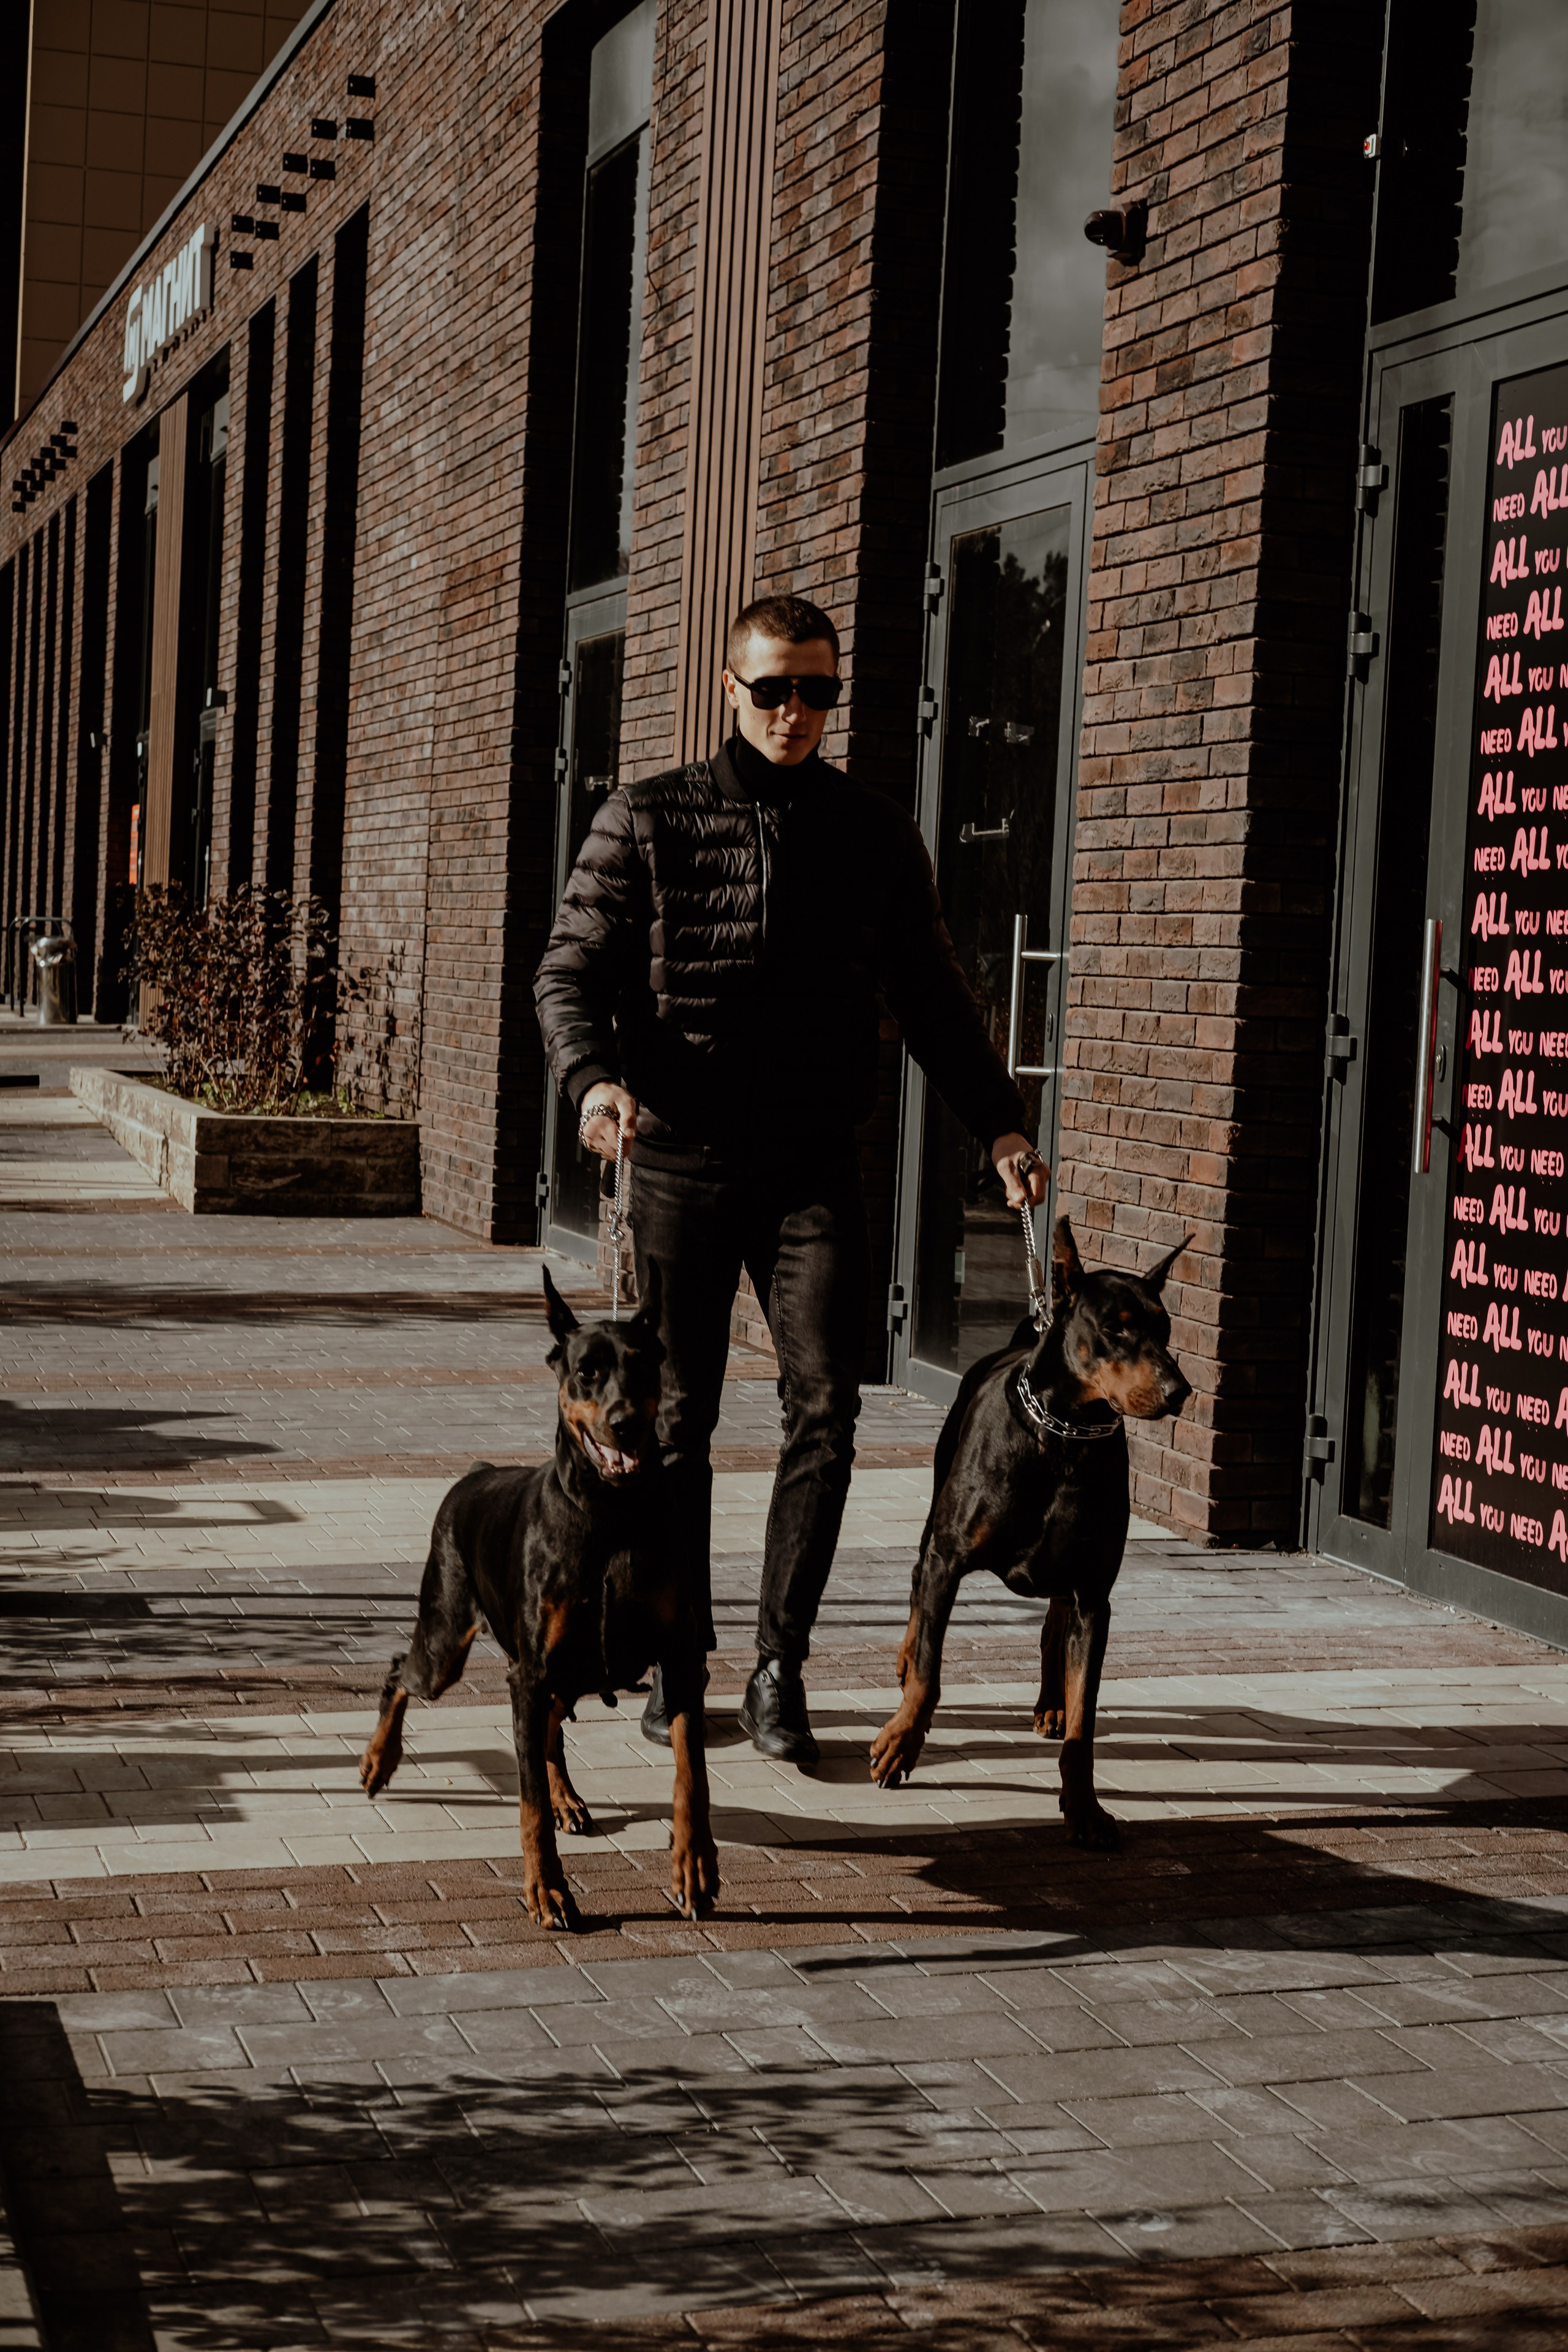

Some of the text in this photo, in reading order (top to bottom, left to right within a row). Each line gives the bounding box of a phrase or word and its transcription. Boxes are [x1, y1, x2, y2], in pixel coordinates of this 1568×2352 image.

[140, 222, 206, 368] МАГНИТ
[1496, 415, 1568, 470] ALL YOU
[1493, 463, 1568, 522] NEED ALL
[1490, 535, 1561, 589] ALL YOU
[1487, 586, 1565, 641] NEED ALL
[1483, 651, 1524, 704] ALL
[1528, 666, 1554, 693] YOU
[1480, 728, 1512, 755] NEED
[1517, 704, 1558, 758] ALL
[1477, 771, 1568, 823] ALL YOU NE
[1474, 826, 1568, 878] NEED ALL YO
[1471, 892, 1568, 943] ALL YOU NEE
[1469, 967, 1499, 992] NEED
[1504, 949, 1545, 1000] ALL
[1464, 1009, 1504, 1060] ALL
[1509, 1030, 1534, 1056] YOU
[1461, 1084, 1493, 1110] NEED
[1498, 1069, 1537, 1120] ALL
[1457, 1122, 1564, 1178] ALL YOU NEED
[1453, 1184, 1561, 1237] NEED ALL YOU
[1450, 1239, 1489, 1289] ALL
[1494, 1264, 1518, 1292] YOU
[1525, 1270, 1558, 1300] NEED
[1447, 1311, 1479, 1341] NEED
[1483, 1302, 1523, 1354] ALL
[1528, 1329, 1554, 1358] YOU
[1443, 1359, 1482, 1409] ALL
[1487, 1385, 1511, 1415] YOU
[1517, 1394, 1550, 1426] NEED
[1440, 1424, 1568, 1491] NEED ALL YOU NE
[1438, 1474, 1476, 1525] ALL
[1480, 1503, 1505, 1533] YOU
[1510, 1513, 1544, 1547] NEED
